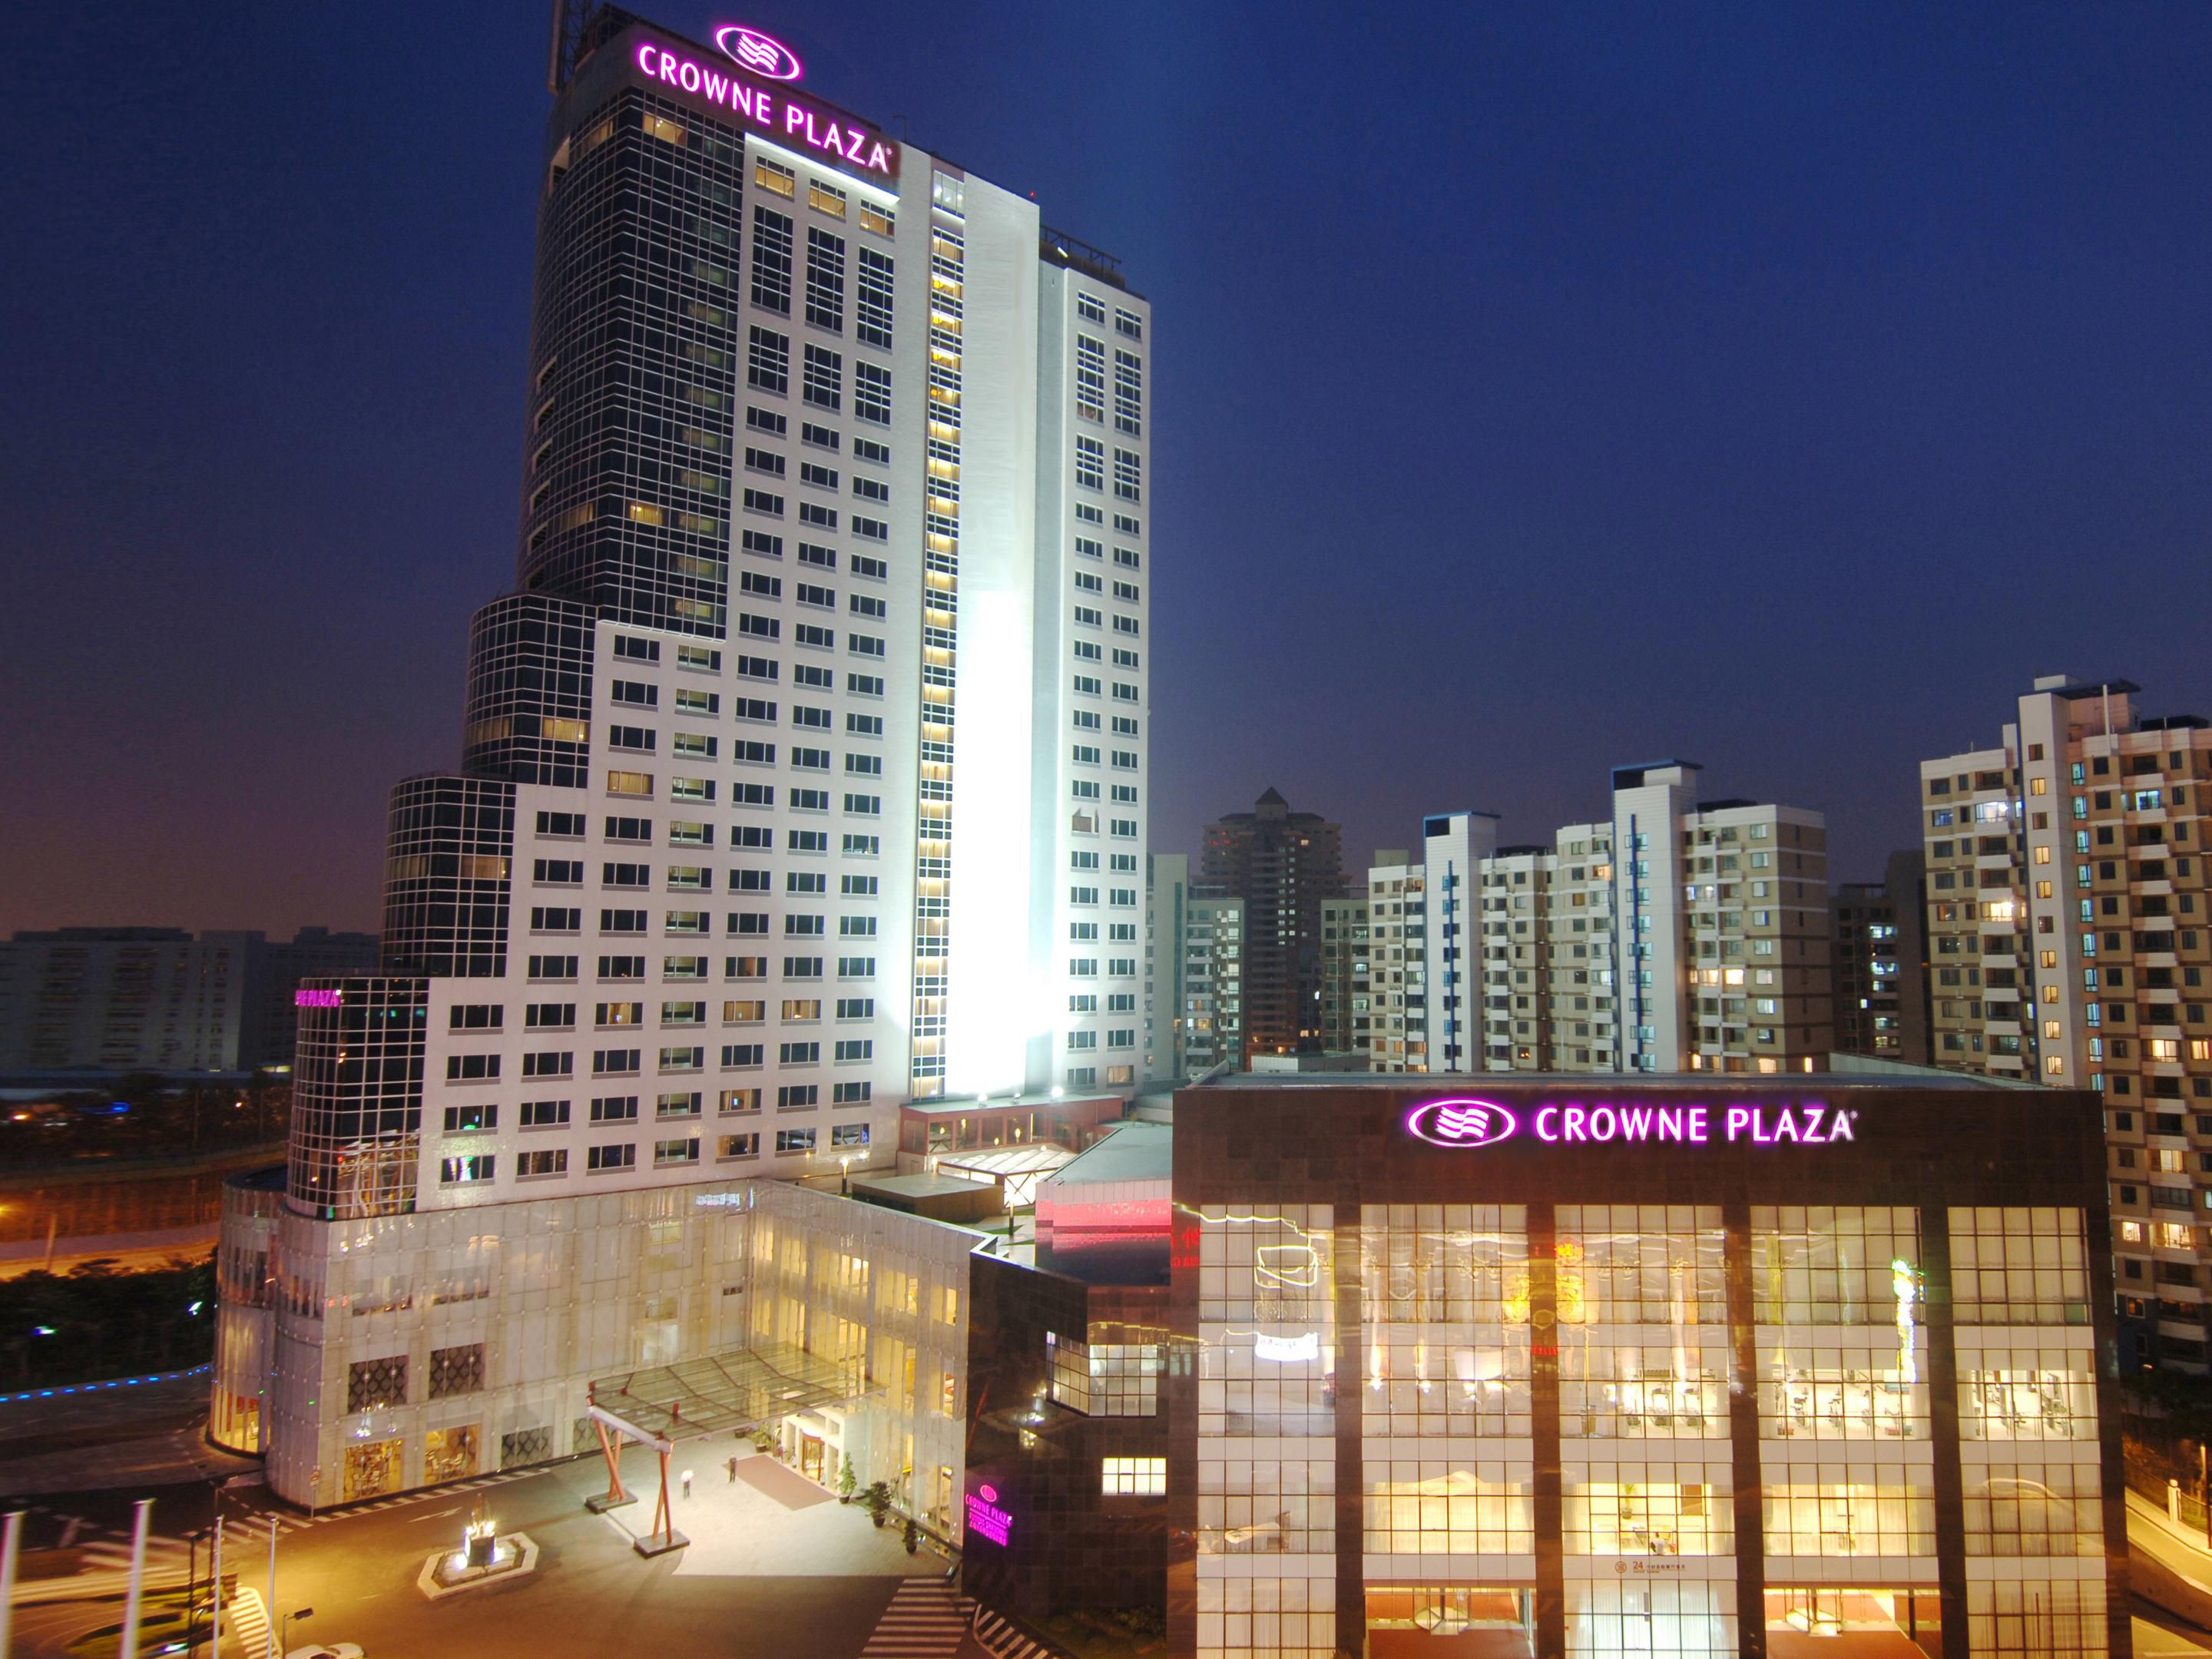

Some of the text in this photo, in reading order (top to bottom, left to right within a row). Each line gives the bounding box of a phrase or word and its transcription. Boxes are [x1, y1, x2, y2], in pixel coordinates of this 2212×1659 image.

[637, 44, 891, 174] CROWNE PLAZA
[308, 989, 339, 1007] PLAZA
[1535, 1107, 1856, 1142] CROWNE PLAZA
[965, 1494, 989, 1516] CROWNE
[1633, 1561, 1644, 1569] 24
